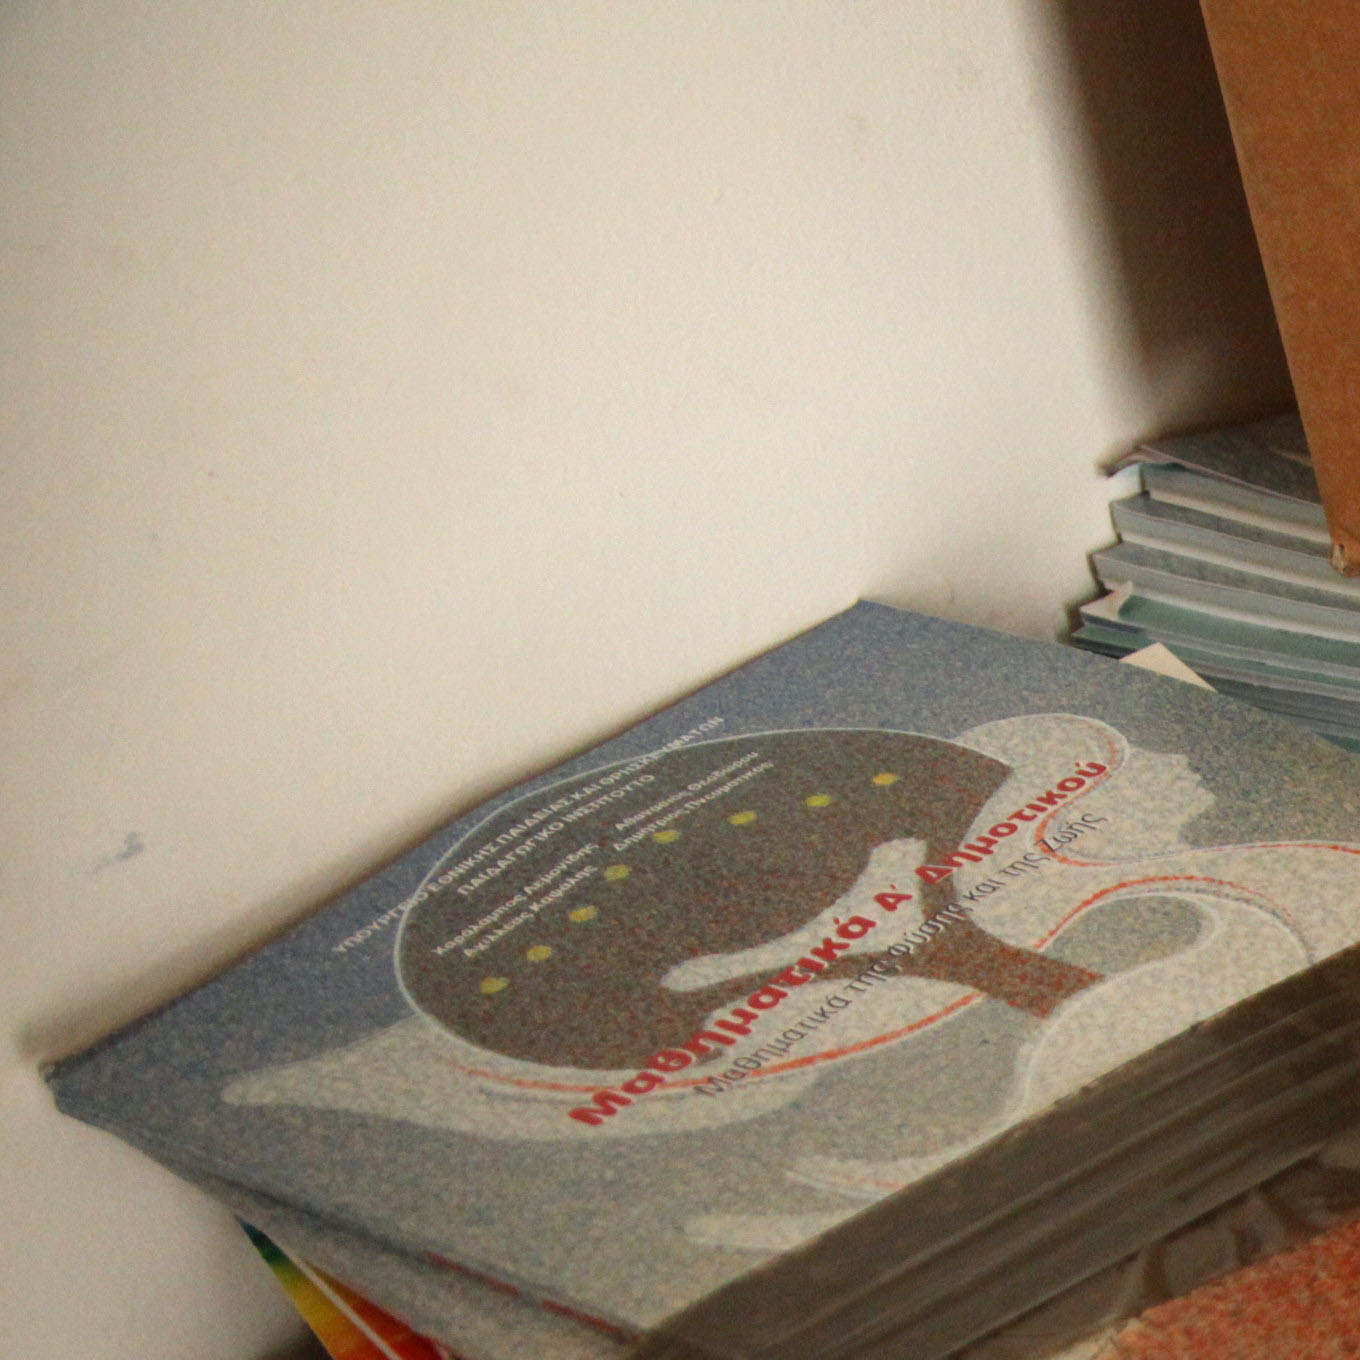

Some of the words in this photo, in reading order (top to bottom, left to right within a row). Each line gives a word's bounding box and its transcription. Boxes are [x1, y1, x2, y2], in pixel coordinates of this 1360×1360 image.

[568, 912, 878, 1127] Μαθηματικά
[914, 759, 1109, 886] Δημοτικού
[694, 991, 854, 1099] Μαθηματικά
[886, 898, 977, 966] φύσης
[964, 874, 1009, 910] και
